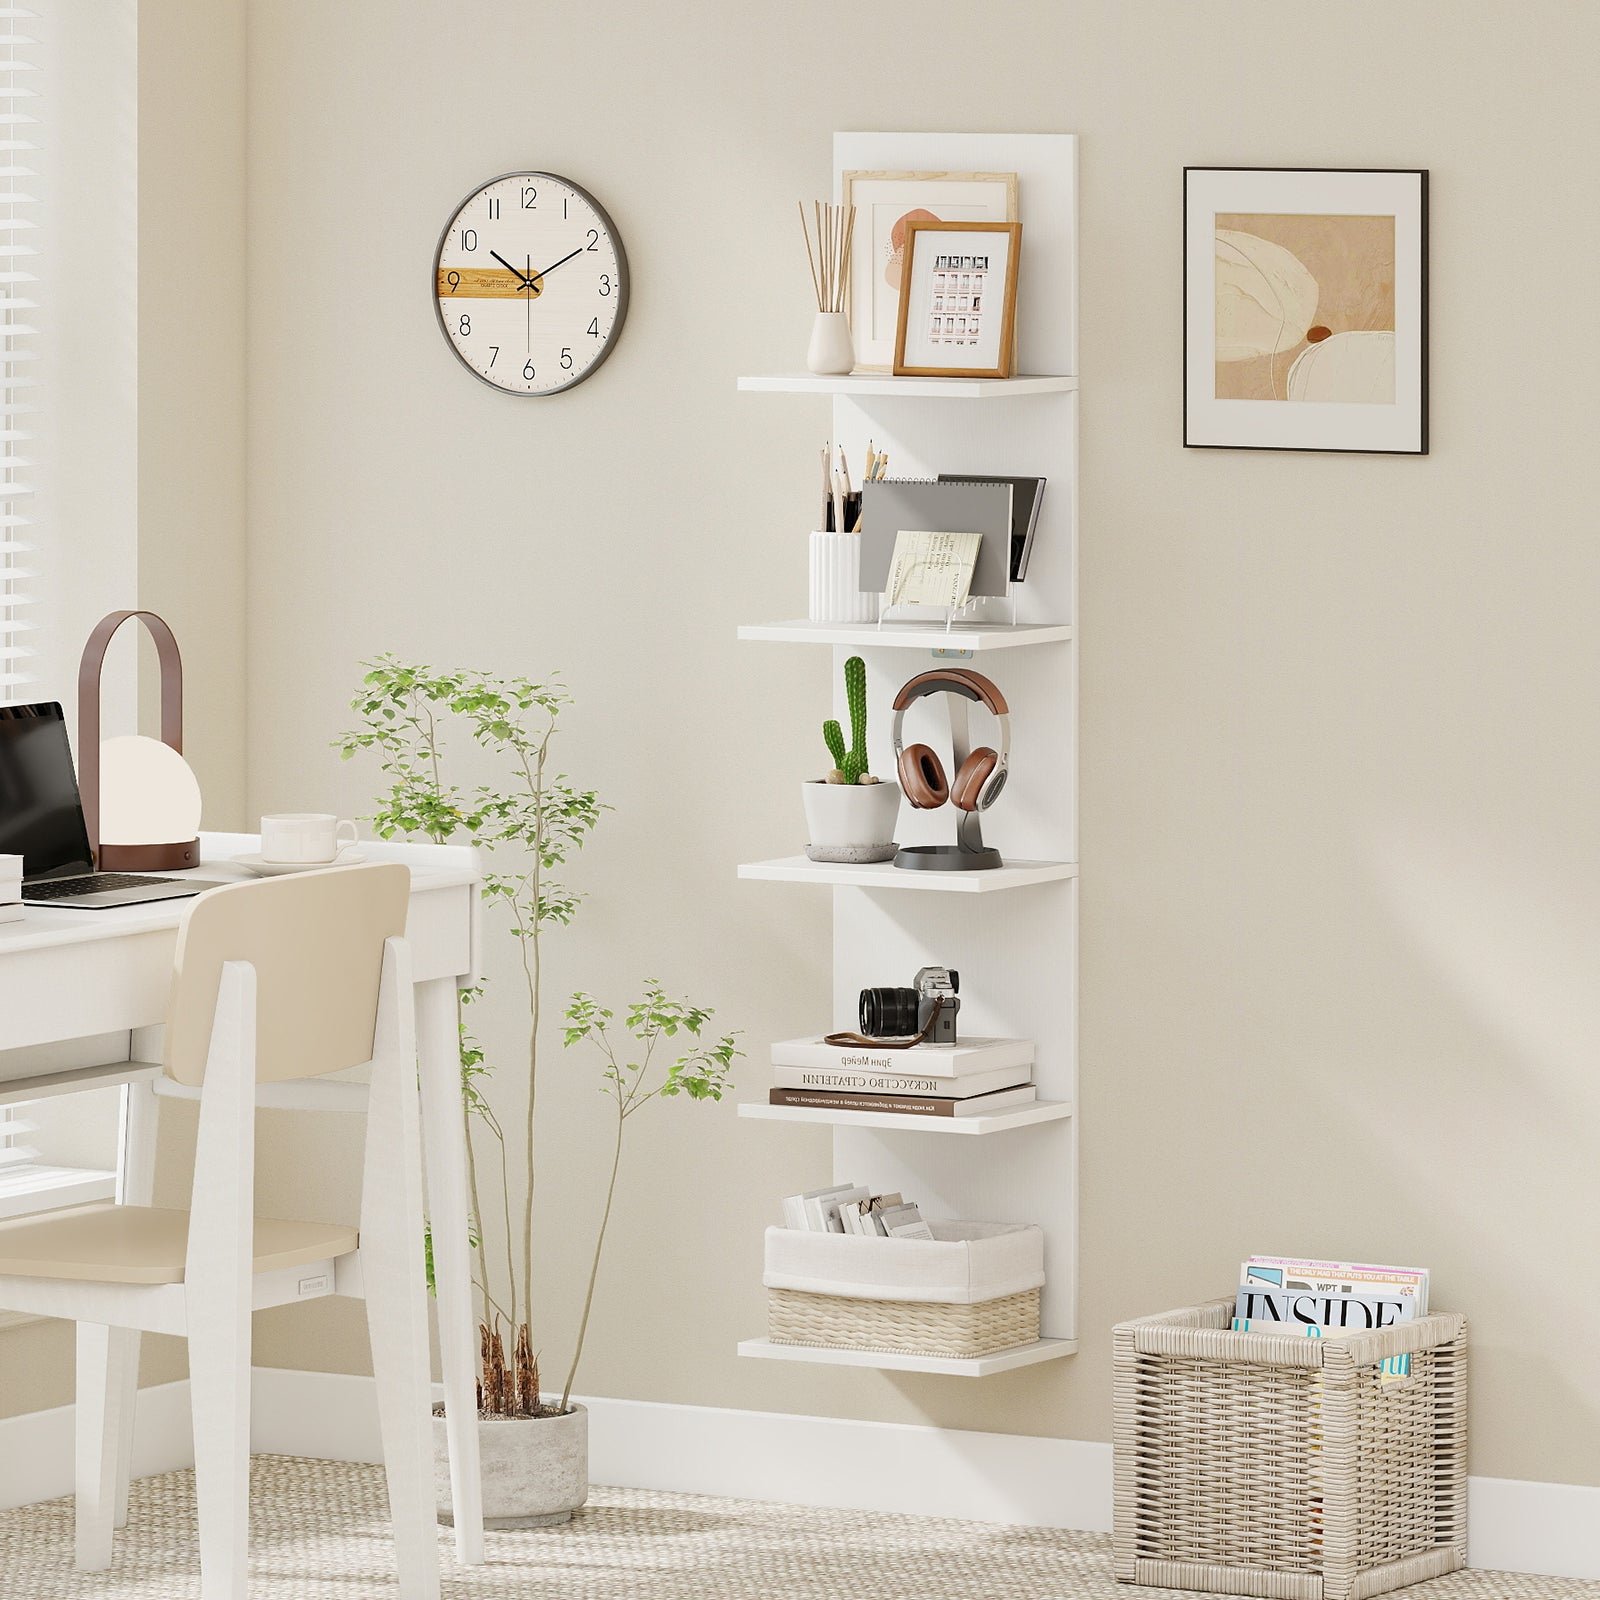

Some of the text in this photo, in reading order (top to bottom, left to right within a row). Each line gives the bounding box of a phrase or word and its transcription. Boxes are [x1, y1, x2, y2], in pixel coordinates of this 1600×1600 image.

[489, 198, 500, 221] 11
[520, 186, 537, 210] 12
[461, 229, 478, 252] 10
[586, 228, 599, 252] 2
[447, 270, 461, 294] 9
[598, 273, 611, 297] 3
[459, 313, 472, 337] 8
[586, 316, 600, 339] 4
[488, 346, 500, 368] 7
[559, 347, 573, 370] 5
[522, 358, 536, 381] 6
[1290, 1267, 1299, 1275] THE
[1300, 1268, 1314, 1276] ONLY
[1316, 1269, 1329, 1277] MAG
[1331, 1270, 1345, 1279] THAT
[1363, 1273, 1376, 1281] YOU
[1385, 1274, 1397, 1282] THE
[1397, 1275, 1415, 1283] TABLE
[1316, 1283, 1338, 1292] WPT
[1242, 1293, 1403, 1329] INSIDE
